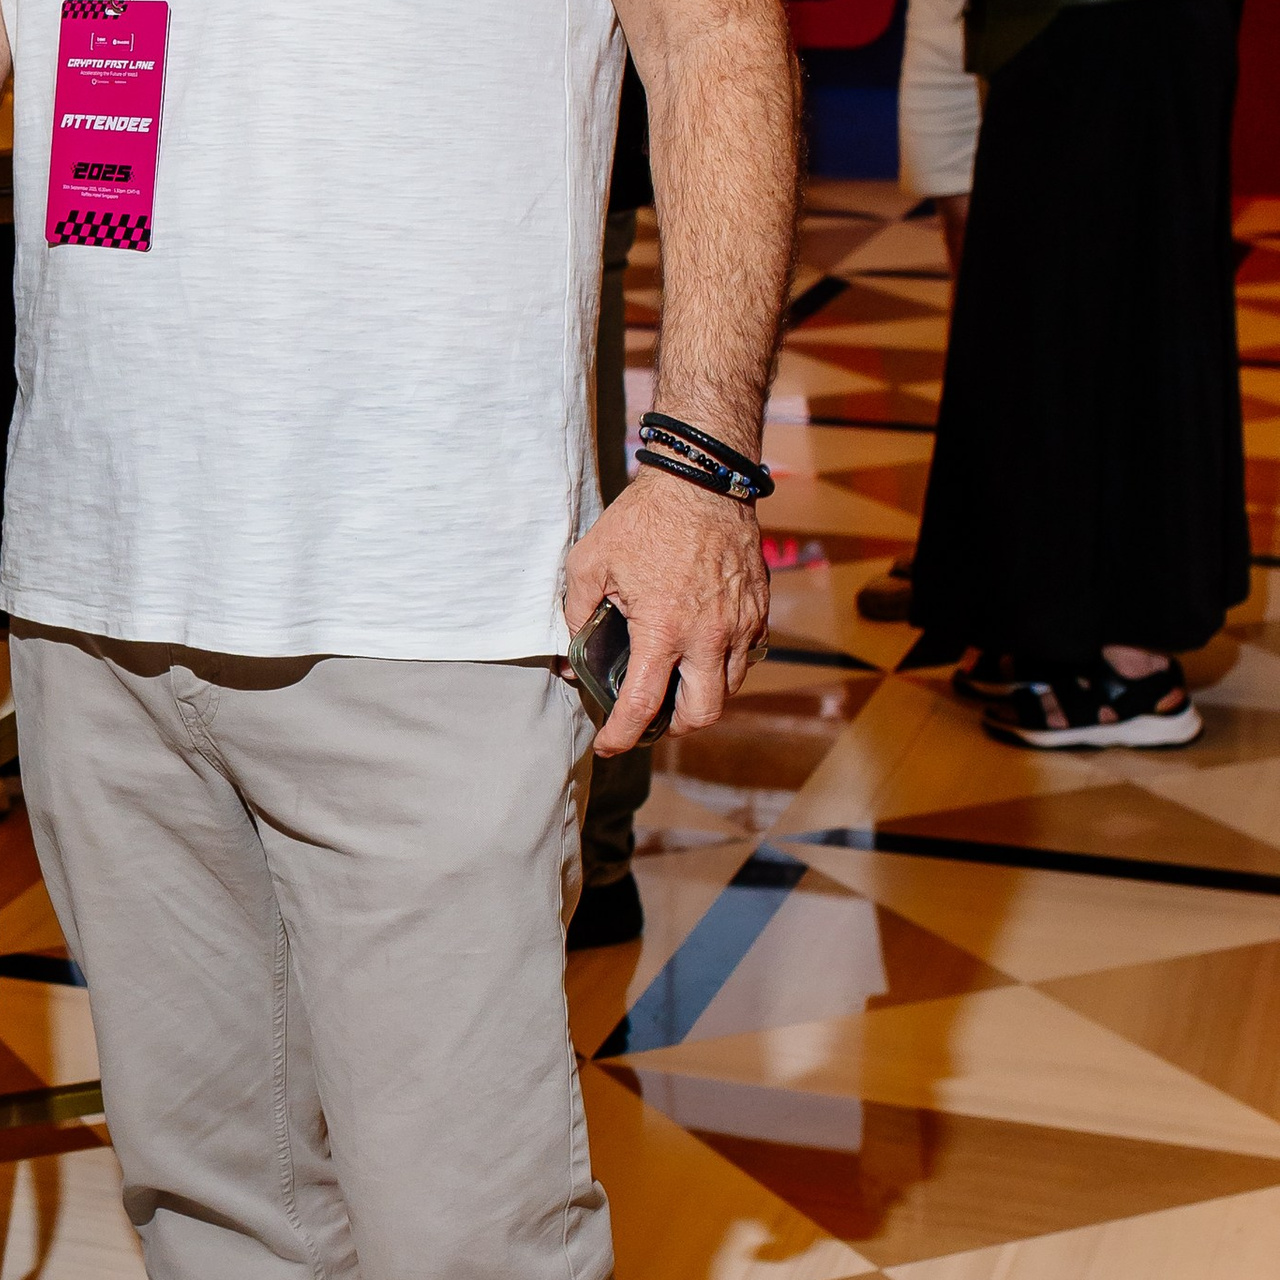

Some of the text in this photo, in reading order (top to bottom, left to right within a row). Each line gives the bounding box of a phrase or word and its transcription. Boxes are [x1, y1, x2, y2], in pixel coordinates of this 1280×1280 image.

[67, 59, 155, 70] CRYPTO FAST LANE
[60, 114, 153, 133] ATTENDEE
[73, 162, 132, 183] 2025
